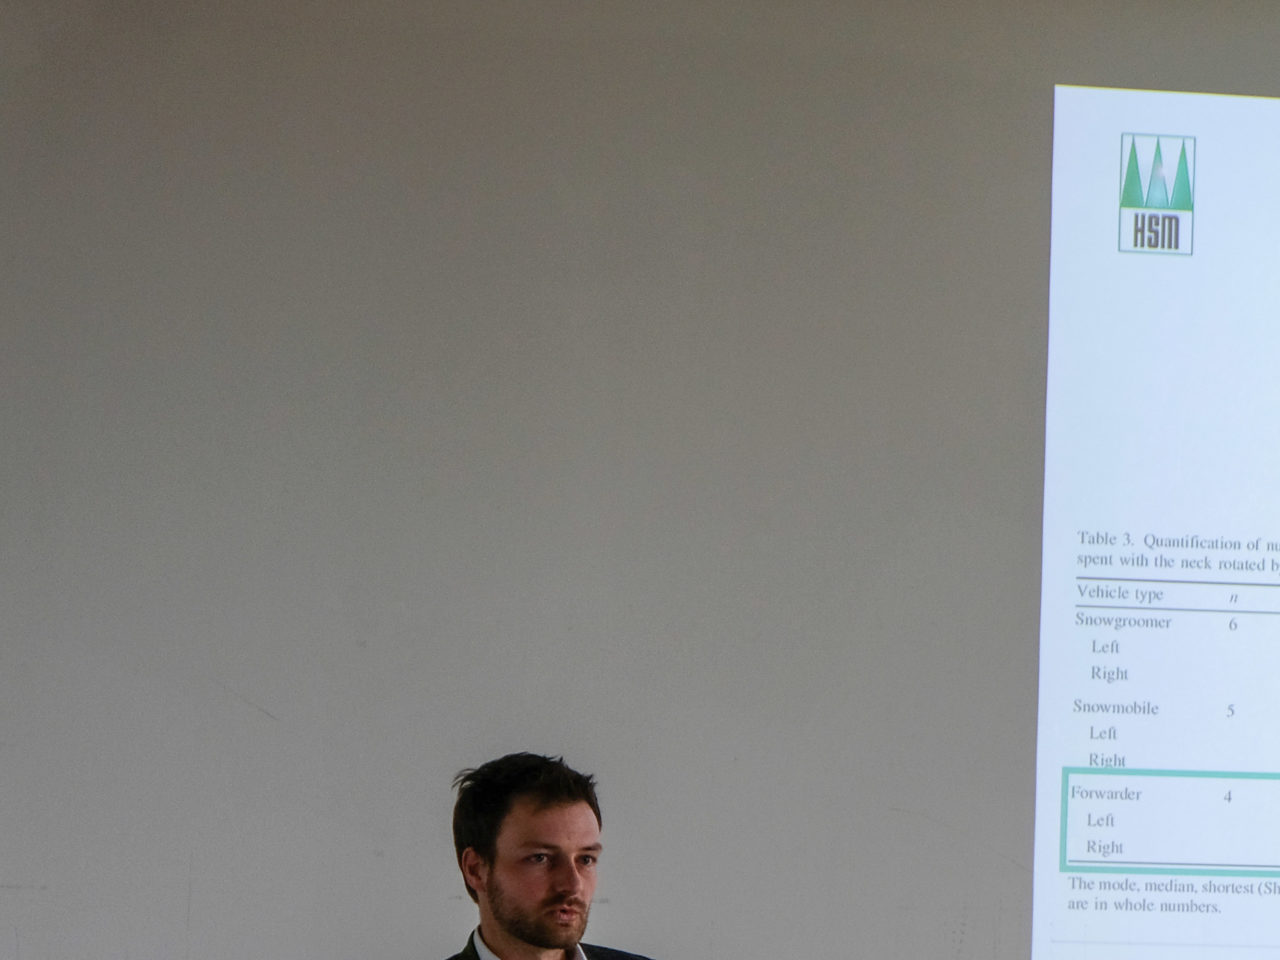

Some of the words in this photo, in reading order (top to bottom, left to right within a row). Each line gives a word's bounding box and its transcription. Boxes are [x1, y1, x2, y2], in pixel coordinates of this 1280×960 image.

[1133, 213, 1180, 251] HSM
[1077, 531, 1117, 546] Table
[1123, 532, 1134, 546] 3.
[1144, 534, 1241, 551] Quantification
[1247, 537, 1261, 551] of
[1077, 555, 1113, 568] spent
[1120, 555, 1148, 567] with
[1154, 556, 1175, 568] the
[1181, 557, 1212, 570] neck
[1219, 559, 1265, 571] rotated
[1077, 585, 1129, 599] Vehicle
[1135, 589, 1163, 603] type
[1075, 614, 1172, 630] Snowgroomer
[1092, 640, 1119, 654] Left
[1091, 665, 1128, 684] Right
[1073, 699, 1159, 715] Snowmobile
[1090, 726, 1117, 740] Left
[1072, 785, 1142, 800] Forwarder
[1088, 813, 1114, 827] Left
[1087, 840, 1123, 858] Right
[1068, 876, 1095, 890] The
[1099, 878, 1140, 893] mode,
[1145, 879, 1198, 894] median,
[1202, 880, 1254, 895] shortest
[1068, 900, 1088, 910] are
[1095, 897, 1108, 911] in
[1114, 898, 1156, 912] whole
[1160, 900, 1221, 913] numbers.
